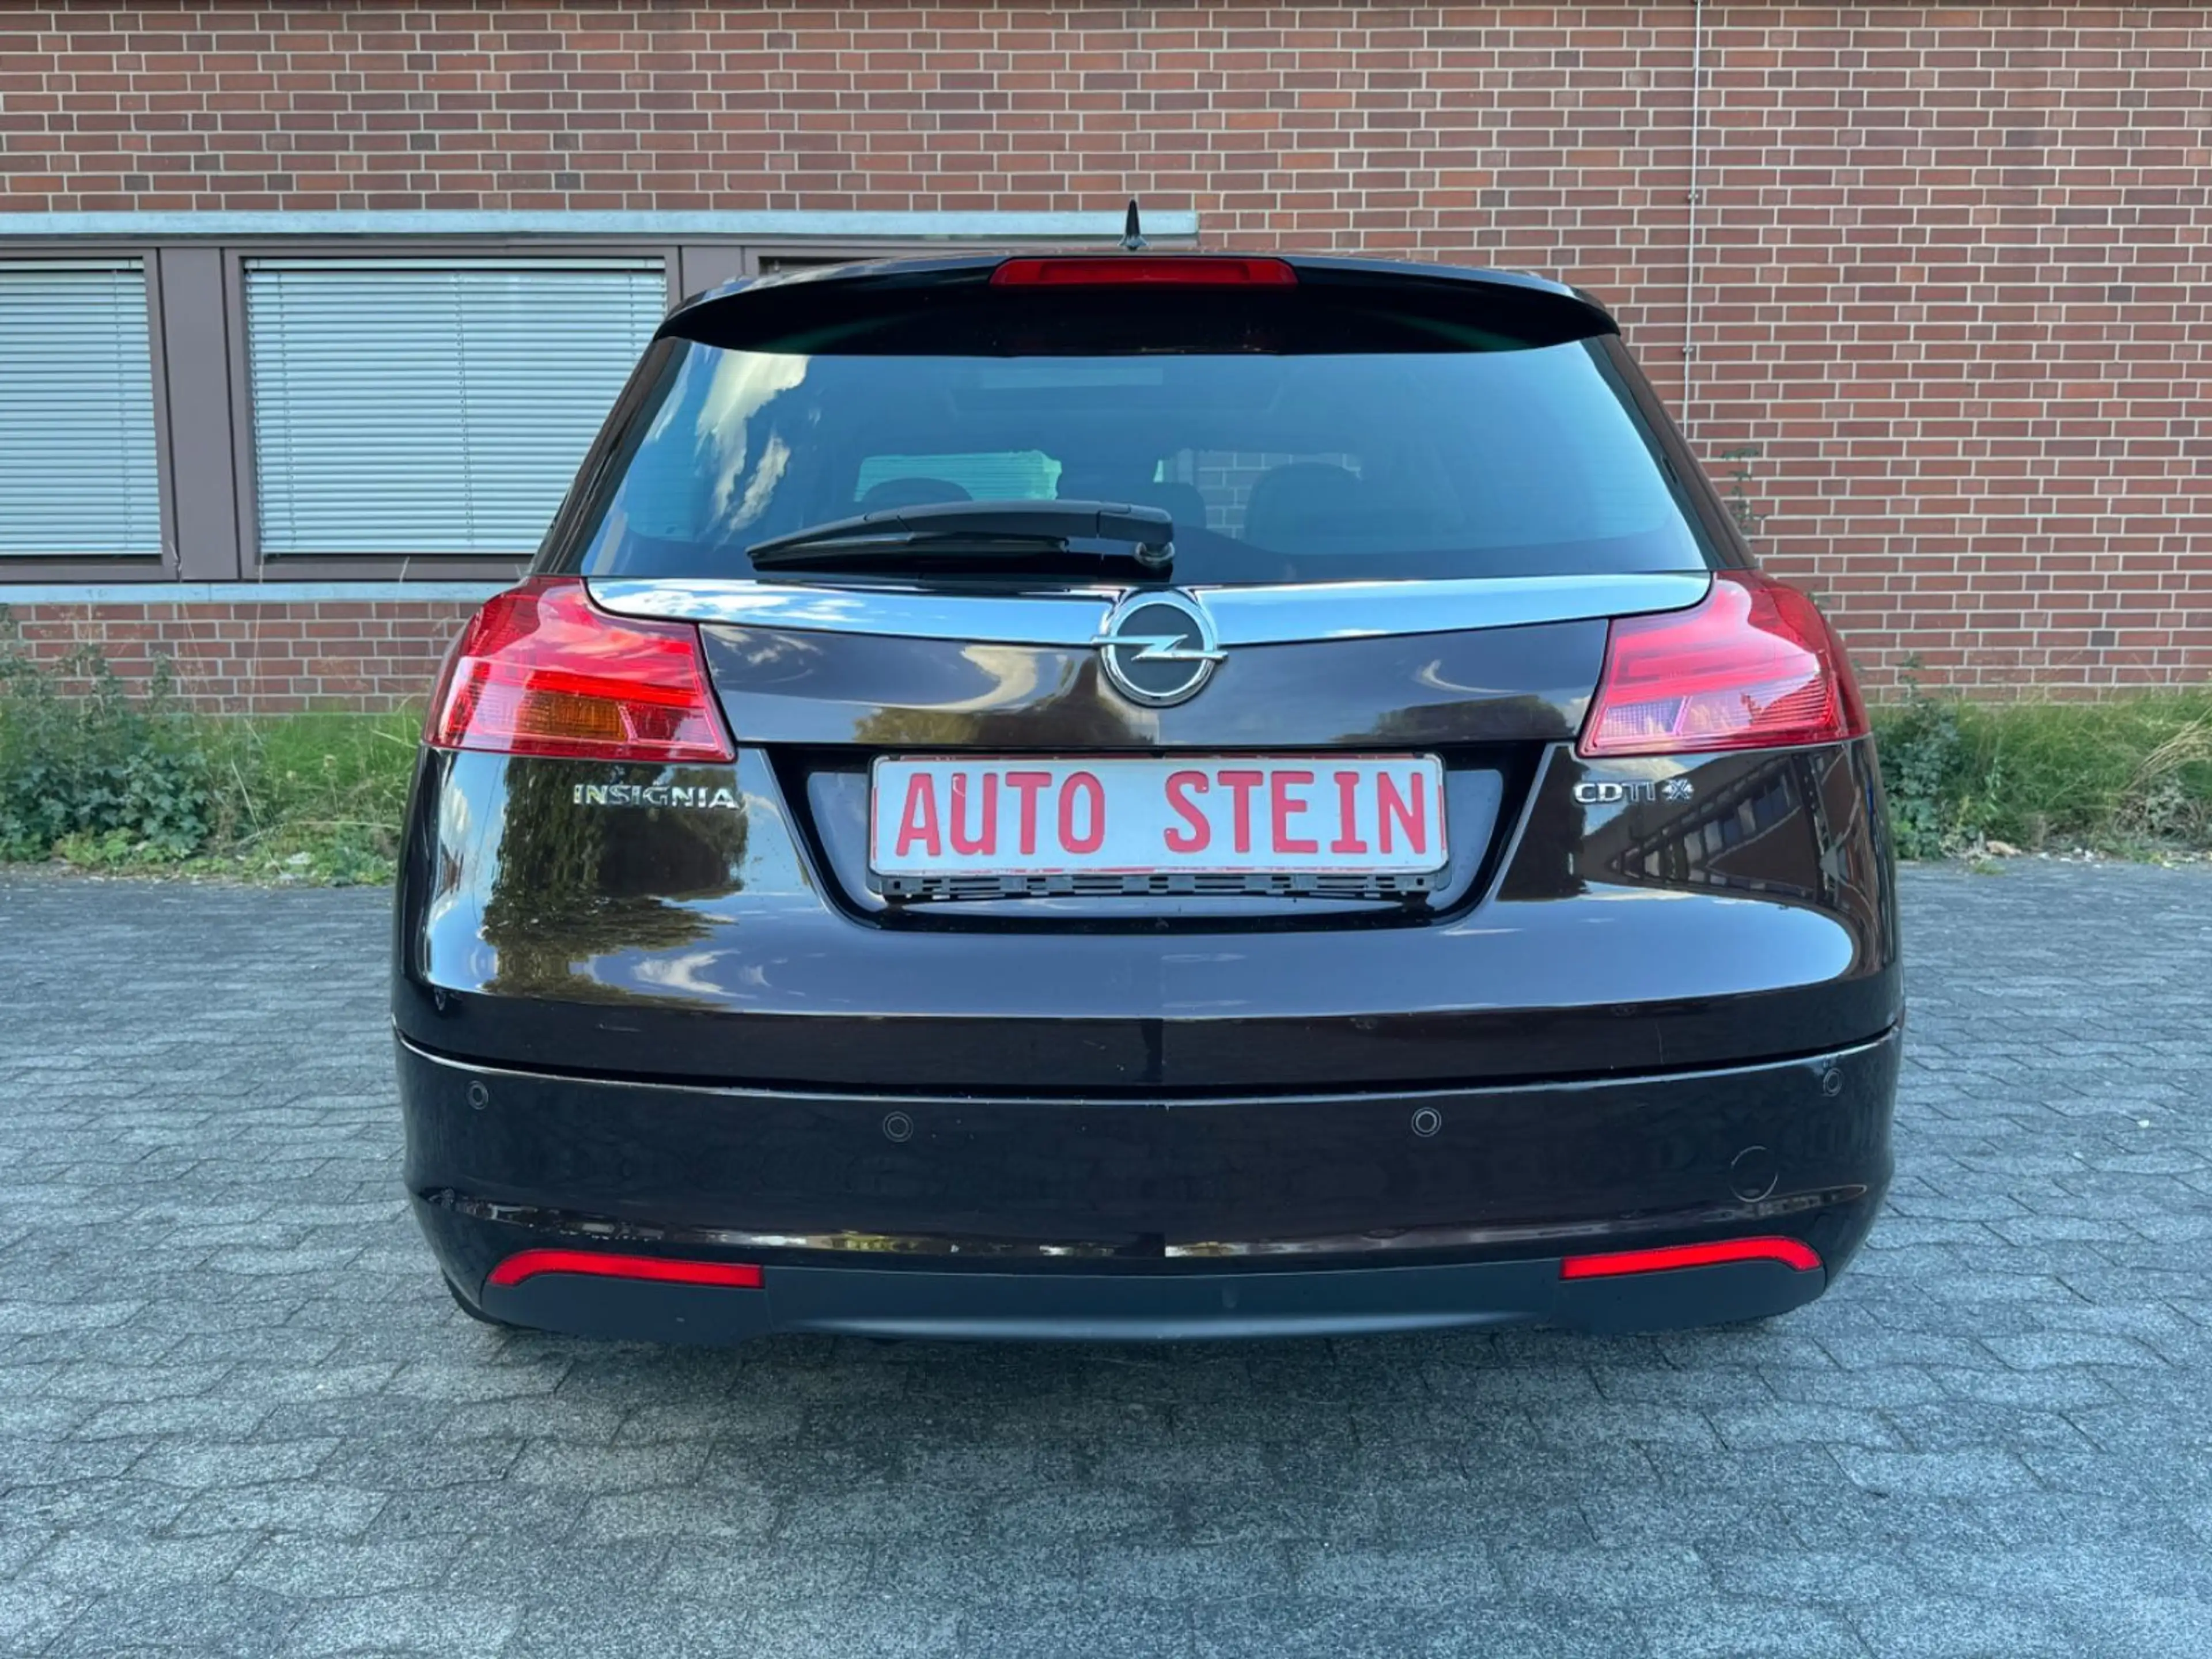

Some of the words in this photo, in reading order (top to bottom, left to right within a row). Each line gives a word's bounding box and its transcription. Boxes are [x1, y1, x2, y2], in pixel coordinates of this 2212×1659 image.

[573, 784, 739, 809] INSIGNIA
[1574, 782, 1656, 803] CDTI
[896, 771, 1105, 856] AUTO
[1164, 770, 1426, 854] STEIN
